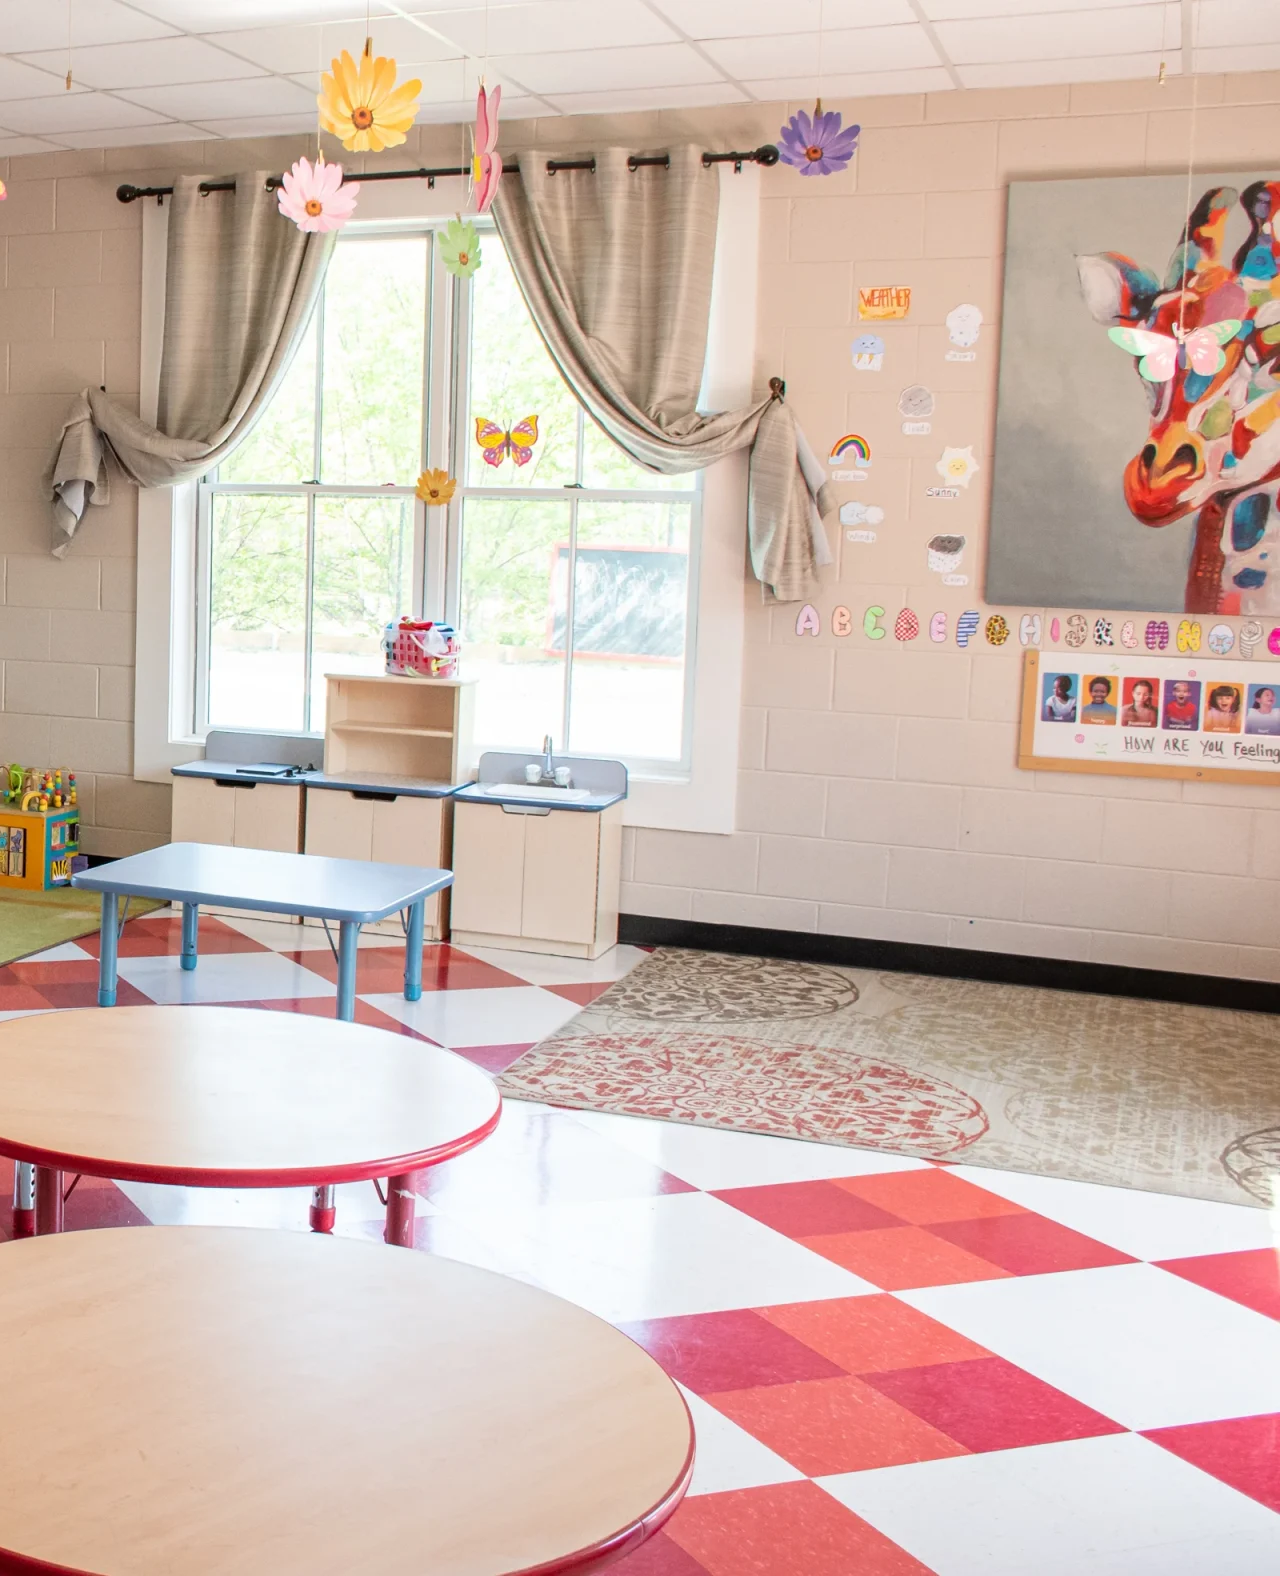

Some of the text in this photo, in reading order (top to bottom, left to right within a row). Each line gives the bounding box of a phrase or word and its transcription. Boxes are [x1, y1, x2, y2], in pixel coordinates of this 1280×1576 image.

[860, 287, 911, 312] WEATHER
[926, 488, 956, 498] Sunny
[1124, 736, 1280, 764] HOW ARE YOU Feeling
